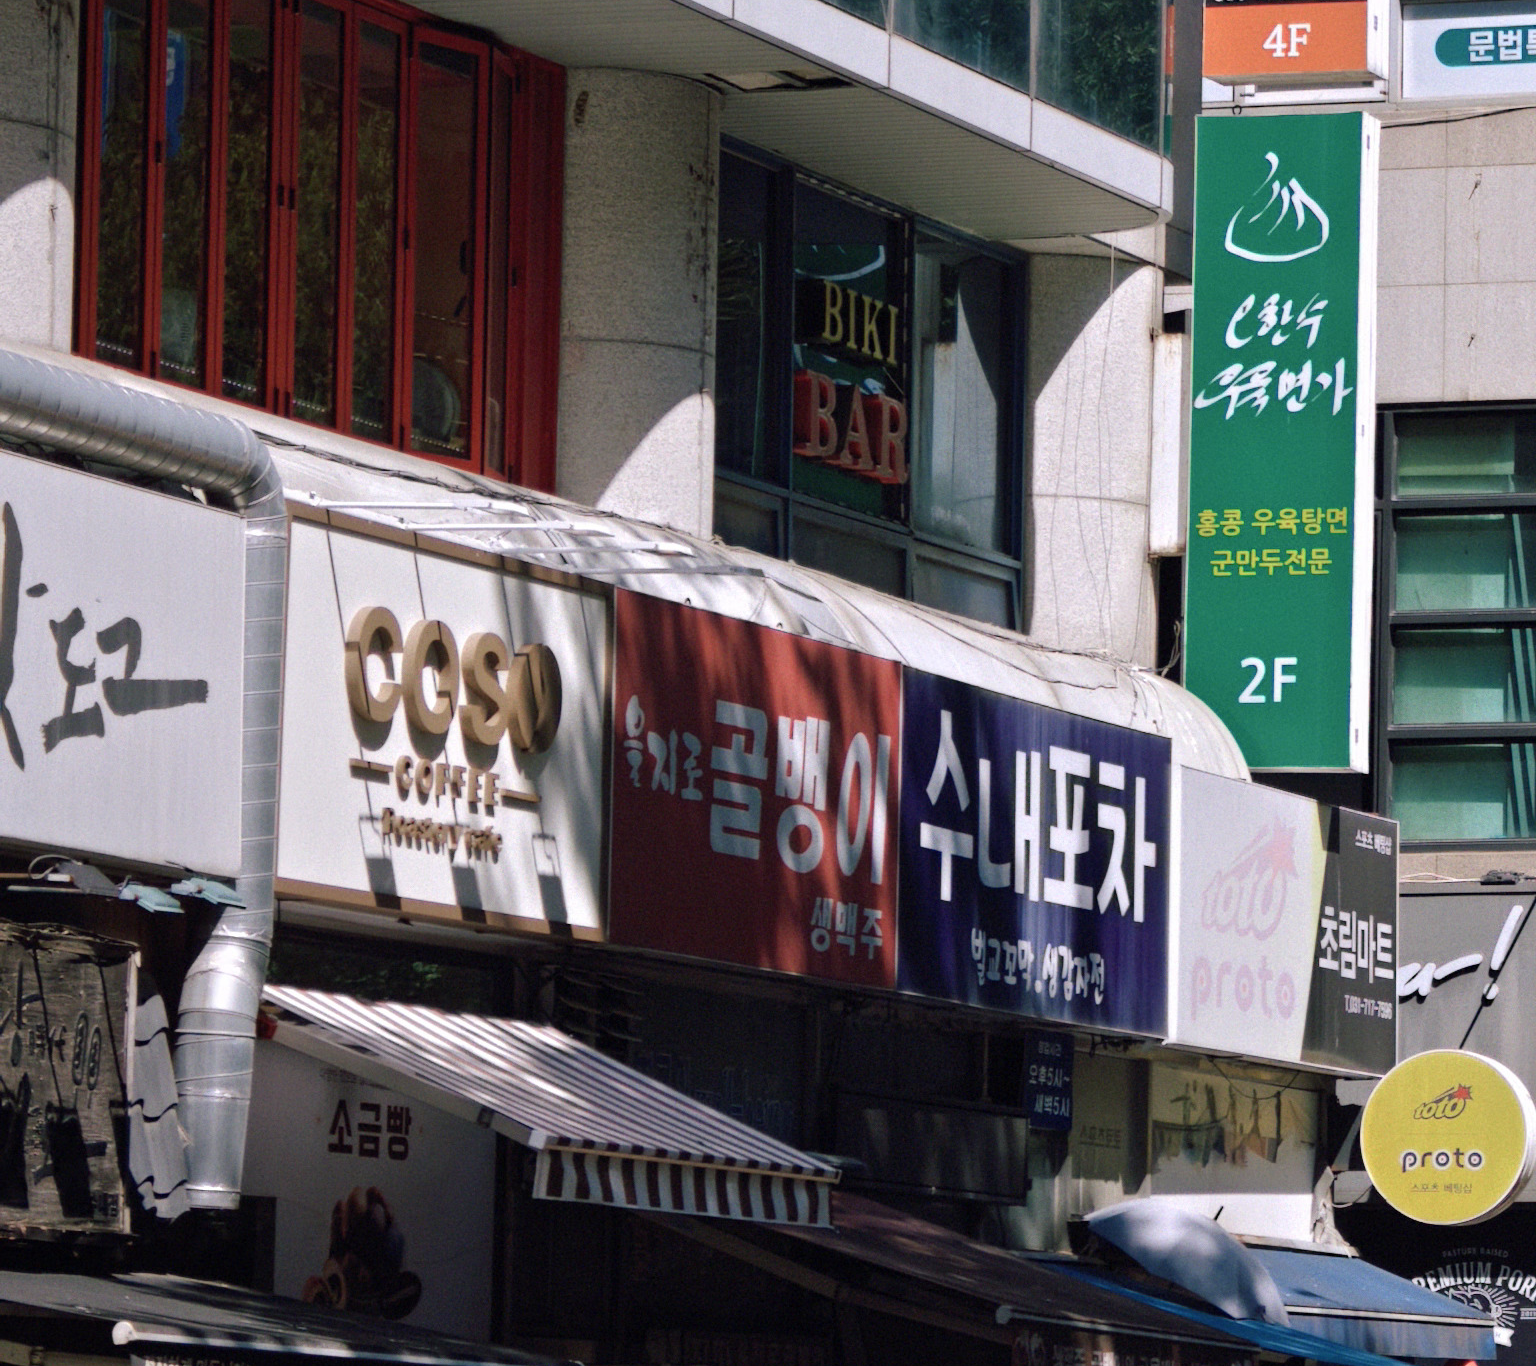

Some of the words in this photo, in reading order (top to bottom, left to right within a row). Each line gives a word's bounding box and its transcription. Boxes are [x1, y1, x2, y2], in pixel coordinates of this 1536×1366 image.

[1262, 22, 1312, 58] 4F
[805, 371, 909, 485] BAR
[1195, 509, 1244, 537] 홍콩
[1251, 506, 1348, 536] 우육탕면
[1210, 547, 1333, 577] 군만두전문
[1237, 657, 1298, 704] 2F
[395, 754, 500, 807] COFFEE
[622, 693, 704, 803] 을지로
[709, 698, 892, 887] 골뱅이
[919, 708, 1158, 924] 수내포차
[809, 897, 884, 960] 생맥주
[1318, 905, 1395, 985] 초림마트
[1190, 953, 1297, 1023] proto
[328, 1100, 413, 1162] 소금빵
[1412, 1095, 1468, 1121] toto
[1401, 1147, 1485, 1174] proto
[1411, 1181, 1440, 1194] 스포츠
[1443, 1181, 1474, 1195] 베팅샵
